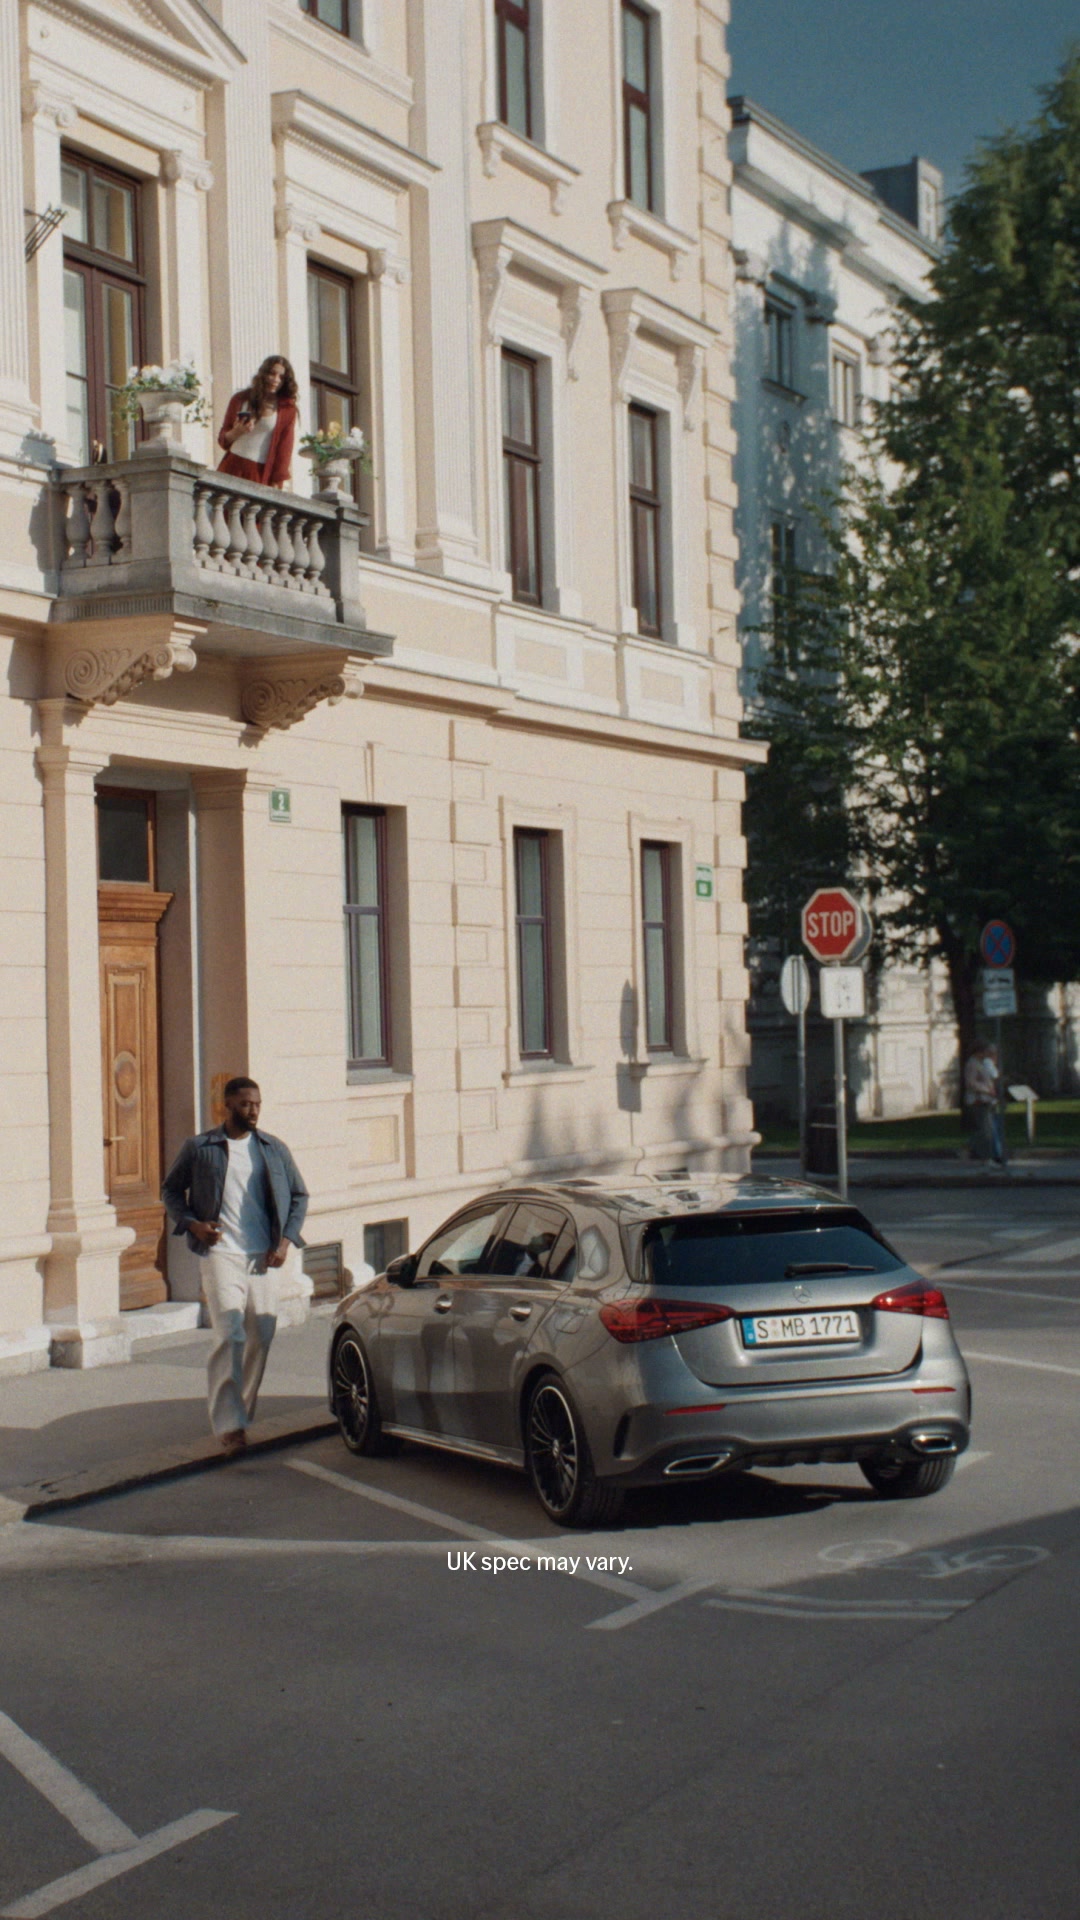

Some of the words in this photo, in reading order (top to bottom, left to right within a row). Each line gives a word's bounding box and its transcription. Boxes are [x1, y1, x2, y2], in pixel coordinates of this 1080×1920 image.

[807, 910, 855, 938] STOP
[756, 1320, 769, 1339] S
[780, 1317, 806, 1338] MB
[809, 1315, 856, 1336] 1771
